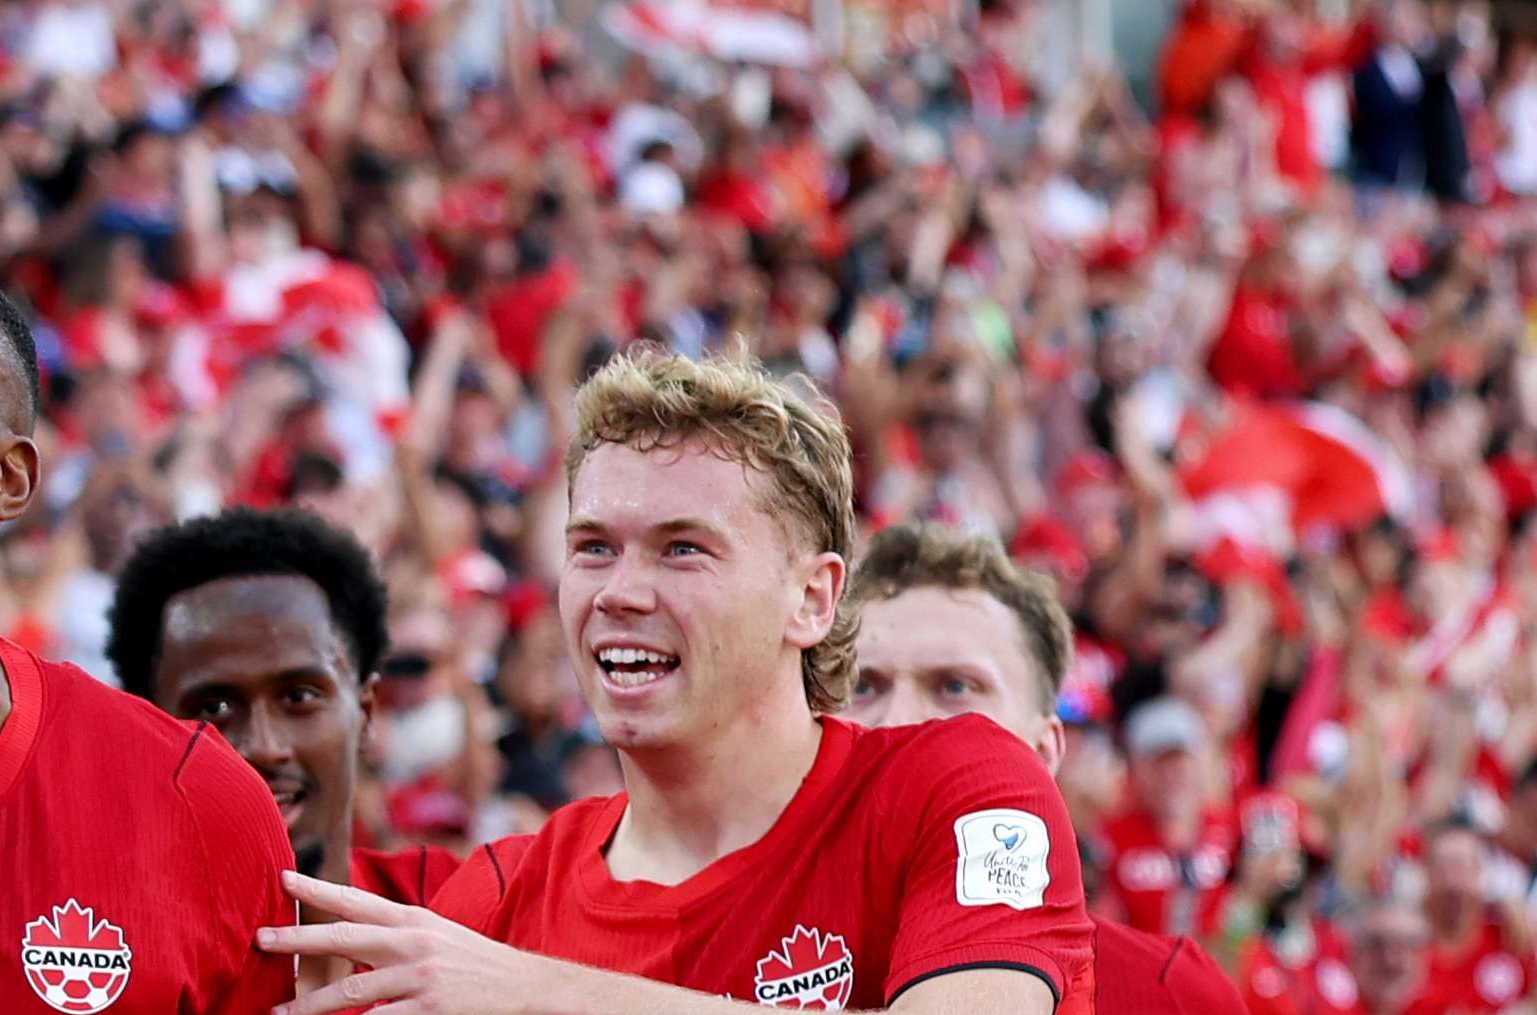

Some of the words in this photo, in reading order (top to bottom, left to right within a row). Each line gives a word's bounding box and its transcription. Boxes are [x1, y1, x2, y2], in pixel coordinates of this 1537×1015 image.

[987, 867, 1030, 888] PEACE
[24, 949, 128, 970] CANADA
[758, 961, 851, 1000] CANADA
